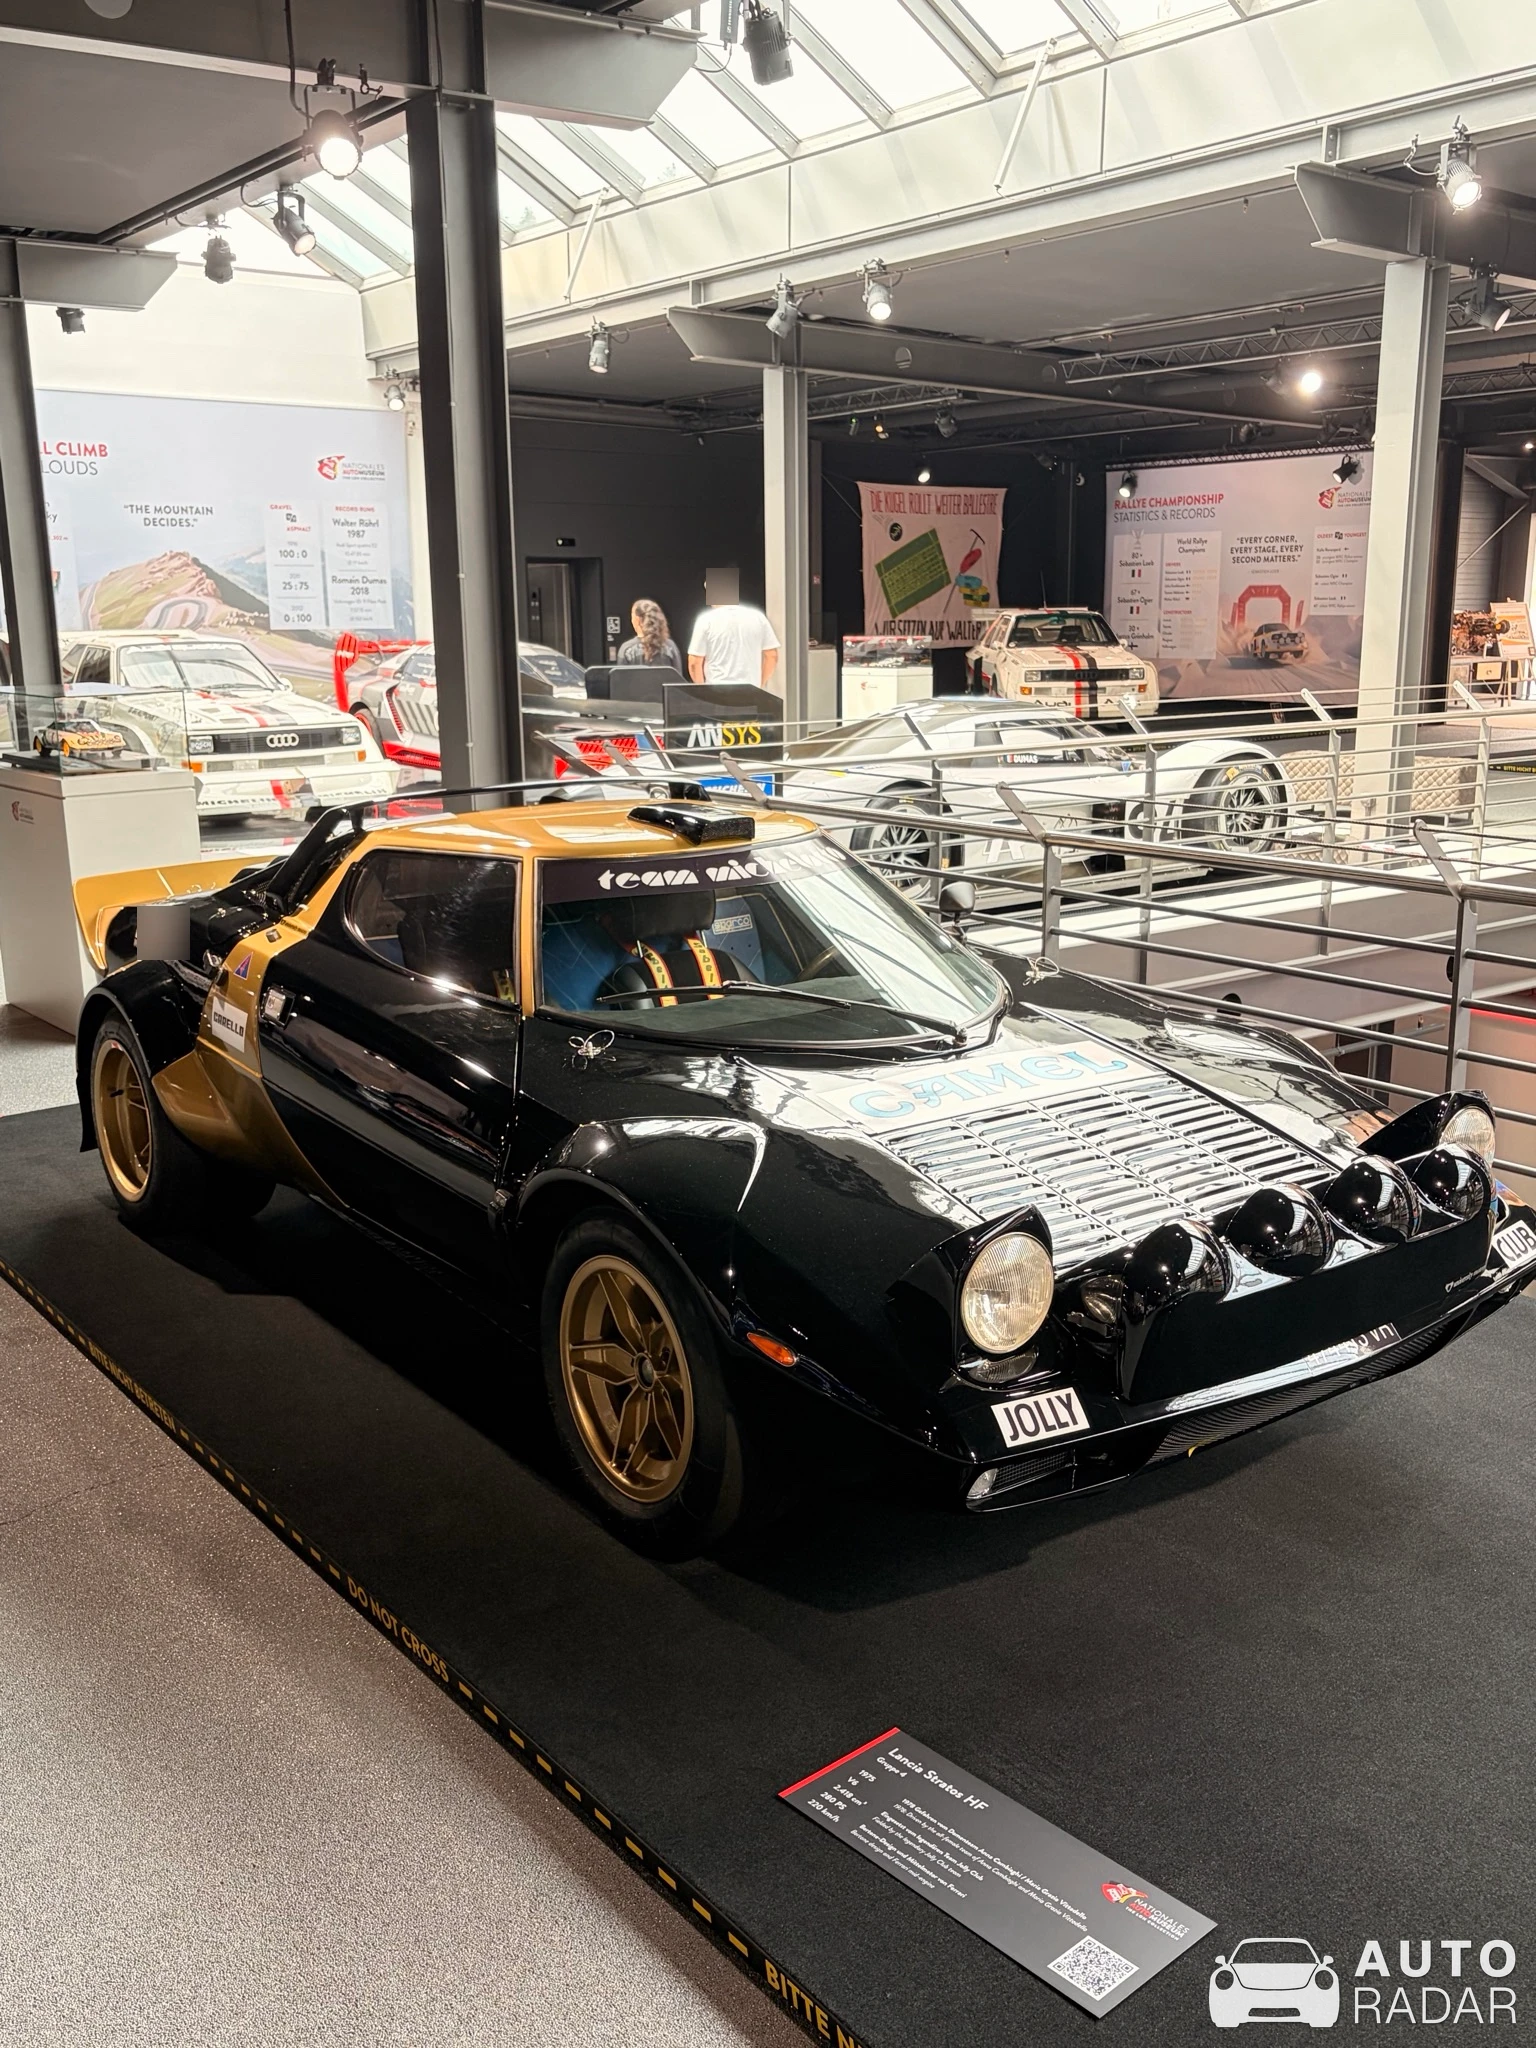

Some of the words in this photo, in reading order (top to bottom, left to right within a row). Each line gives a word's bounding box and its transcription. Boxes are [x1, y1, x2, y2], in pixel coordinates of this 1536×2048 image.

[56, 442, 108, 457] CLIMB
[41, 460, 98, 475] LOUDS
[342, 462, 384, 470] NATIONALES
[1114, 498, 1146, 510] RALLYE
[1148, 493, 1224, 508] CHAMPIONSHIP
[153, 505, 213, 516] MOUNTAIN
[1114, 510, 1159, 523] STATISTICS
[1161, 510, 1168, 520] &
[1170, 507, 1215, 520] RECORDS
[332, 518, 357, 527] Walter
[347, 530, 365, 538] 1987
[1193, 537, 1208, 546] Rallye
[1264, 535, 1297, 543] CORNER,
[279, 550, 295, 558] 100
[1178, 547, 1205, 555] Champions
[1230, 546, 1252, 554] EVERY
[1254, 545, 1278, 554] STAGE,
[1280, 545, 1303, 553] EVERY
[1232, 556, 1261, 564] SECOND
[282, 582, 292, 590] 25
[299, 582, 309, 590] 75
[331, 576, 360, 584] Romain
[361, 576, 387, 584] Dumas
[350, 587, 370, 595] 2018
[297, 614, 312, 622] 100
[687, 722, 761, 747] ANSYS
[1013, 753, 1038, 764] DUMAS
[598, 869, 699, 890] team
[213, 1011, 244, 1037] CARELLO
[849, 1051, 1129, 1118] CAMEL
[1496, 1227, 1536, 1262] CLUB
[109, 1360, 134, 1393] NICHT
[133, 1382, 176, 1433] BETRETEN
[1003, 1393, 1078, 1441] JOLLY
[347, 1576, 368, 1607] DO
[370, 1596, 398, 1637] NOT
[401, 1626, 449, 1682] CROSS
[876, 1756, 900, 1774] Gruppe
[847, 1775, 860, 1786] V6
[858, 1769, 877, 1782] 1975
[887, 1747, 924, 1774] Lancia
[923, 1770, 964, 1799] Stratos
[963, 1794, 989, 1810] HF
[832, 1784, 854, 1799] 2.418
[819, 1791, 837, 1803] 280
[834, 1800, 847, 1810] PS
[807, 1798, 824, 1811] 220
[820, 1807, 840, 1823] km/h
[880, 1810, 907, 1830] Eingesetzt
[905, 1828, 917, 1837] vom
[943, 1852, 958, 1864] Team
[956, 1861, 971, 1873] Jolly
[969, 1870, 984, 1881] Club
[914, 1806, 938, 1824] Gefahren
[936, 1821, 949, 1831] vom
[947, 1828, 979, 1851] Damenteam
[977, 1848, 994, 1860] Anna
[992, 1857, 1024, 1878] Cambiaghi
[1024, 1877, 1042, 1891] Maria
[1041, 1888, 1059, 1902] Grazia
[867, 1842, 884, 1854] design
[882, 1852, 895, 1860] and
[891, 1857, 911, 1871] Ferrari
[894, 1831, 904, 1839] the
[902, 1836, 926, 1854] legendary
[923, 1852, 938, 1862] Jolly
[936, 1859, 950, 1870] Club
[947, 1867, 962, 1878] team
[905, 1811, 922, 1824] Driven
[927, 1826, 937, 1834] the
[958, 1846, 973, 1857] team
[977, 1859, 992, 1870] Anna
[1017, 1885, 1031, 1894] and
[1027, 1891, 1045, 1904] Maria
[1044, 1901, 1062, 1915] Grazia
[896, 1849, 909, 1859] und
[937, 1877, 948, 1886] von
[946, 1883, 968, 1898] Ferrari
[1129, 1901, 1185, 1938] AUTOMUSEUM
[1134, 1898, 1190, 1935] NATIONALES
[1146, 1919, 1180, 1941] COLLECTION
[765, 1959, 830, 2040] BITTE
